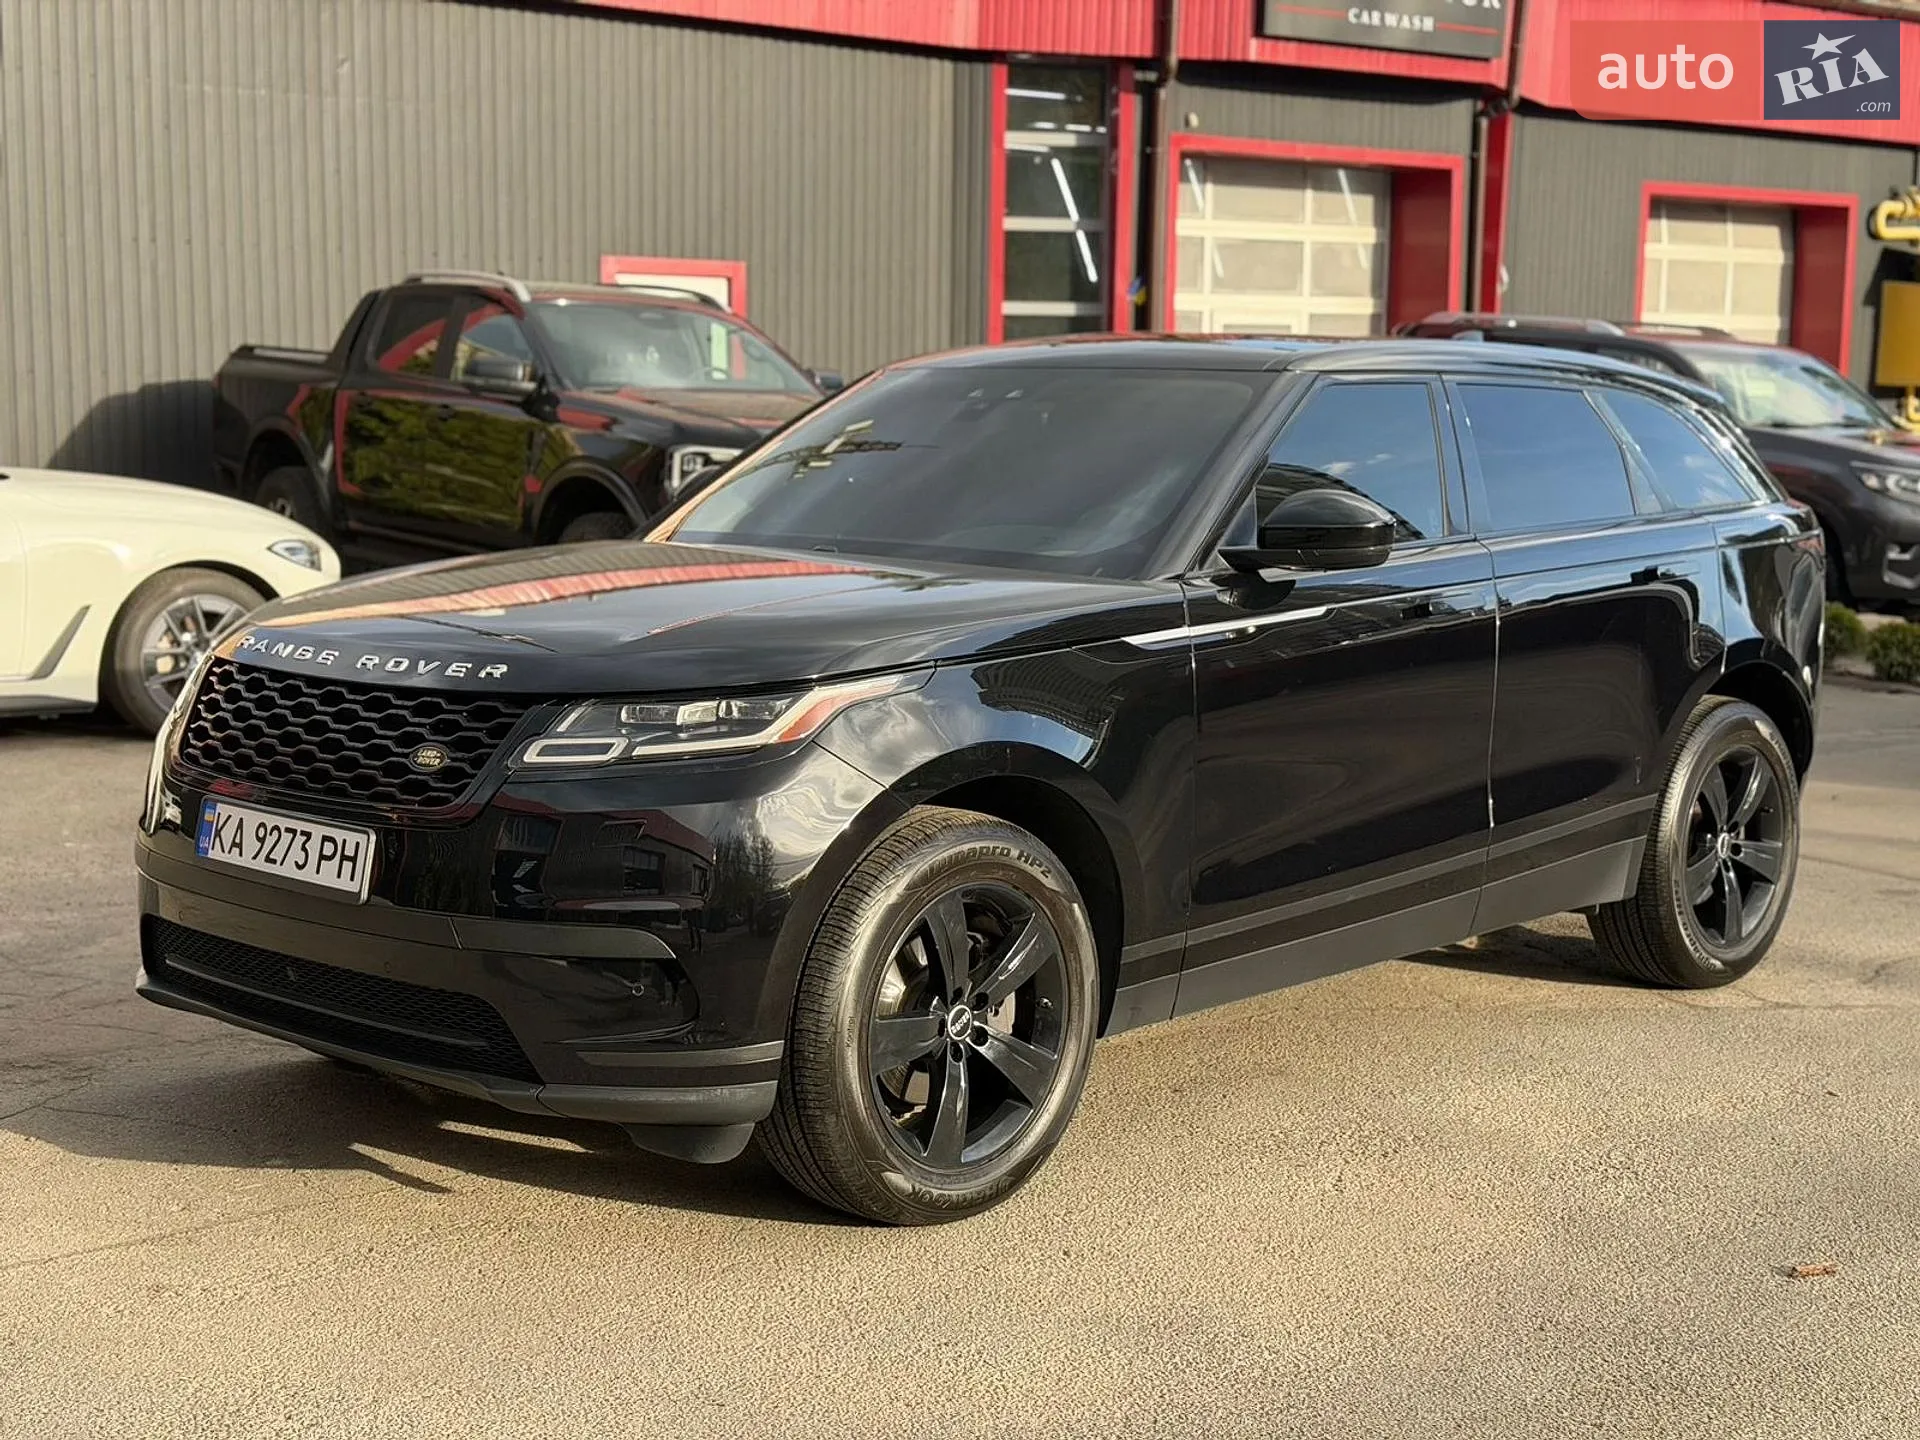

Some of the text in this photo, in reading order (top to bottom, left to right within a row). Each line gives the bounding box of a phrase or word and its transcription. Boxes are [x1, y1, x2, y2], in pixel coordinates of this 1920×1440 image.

[1348, 8, 1434, 32] CAR WASH
[237, 635, 509, 679] RANGE ROVER
[211, 812, 360, 882] KA 9273 PH
[1017, 849, 1053, 880] HP2
